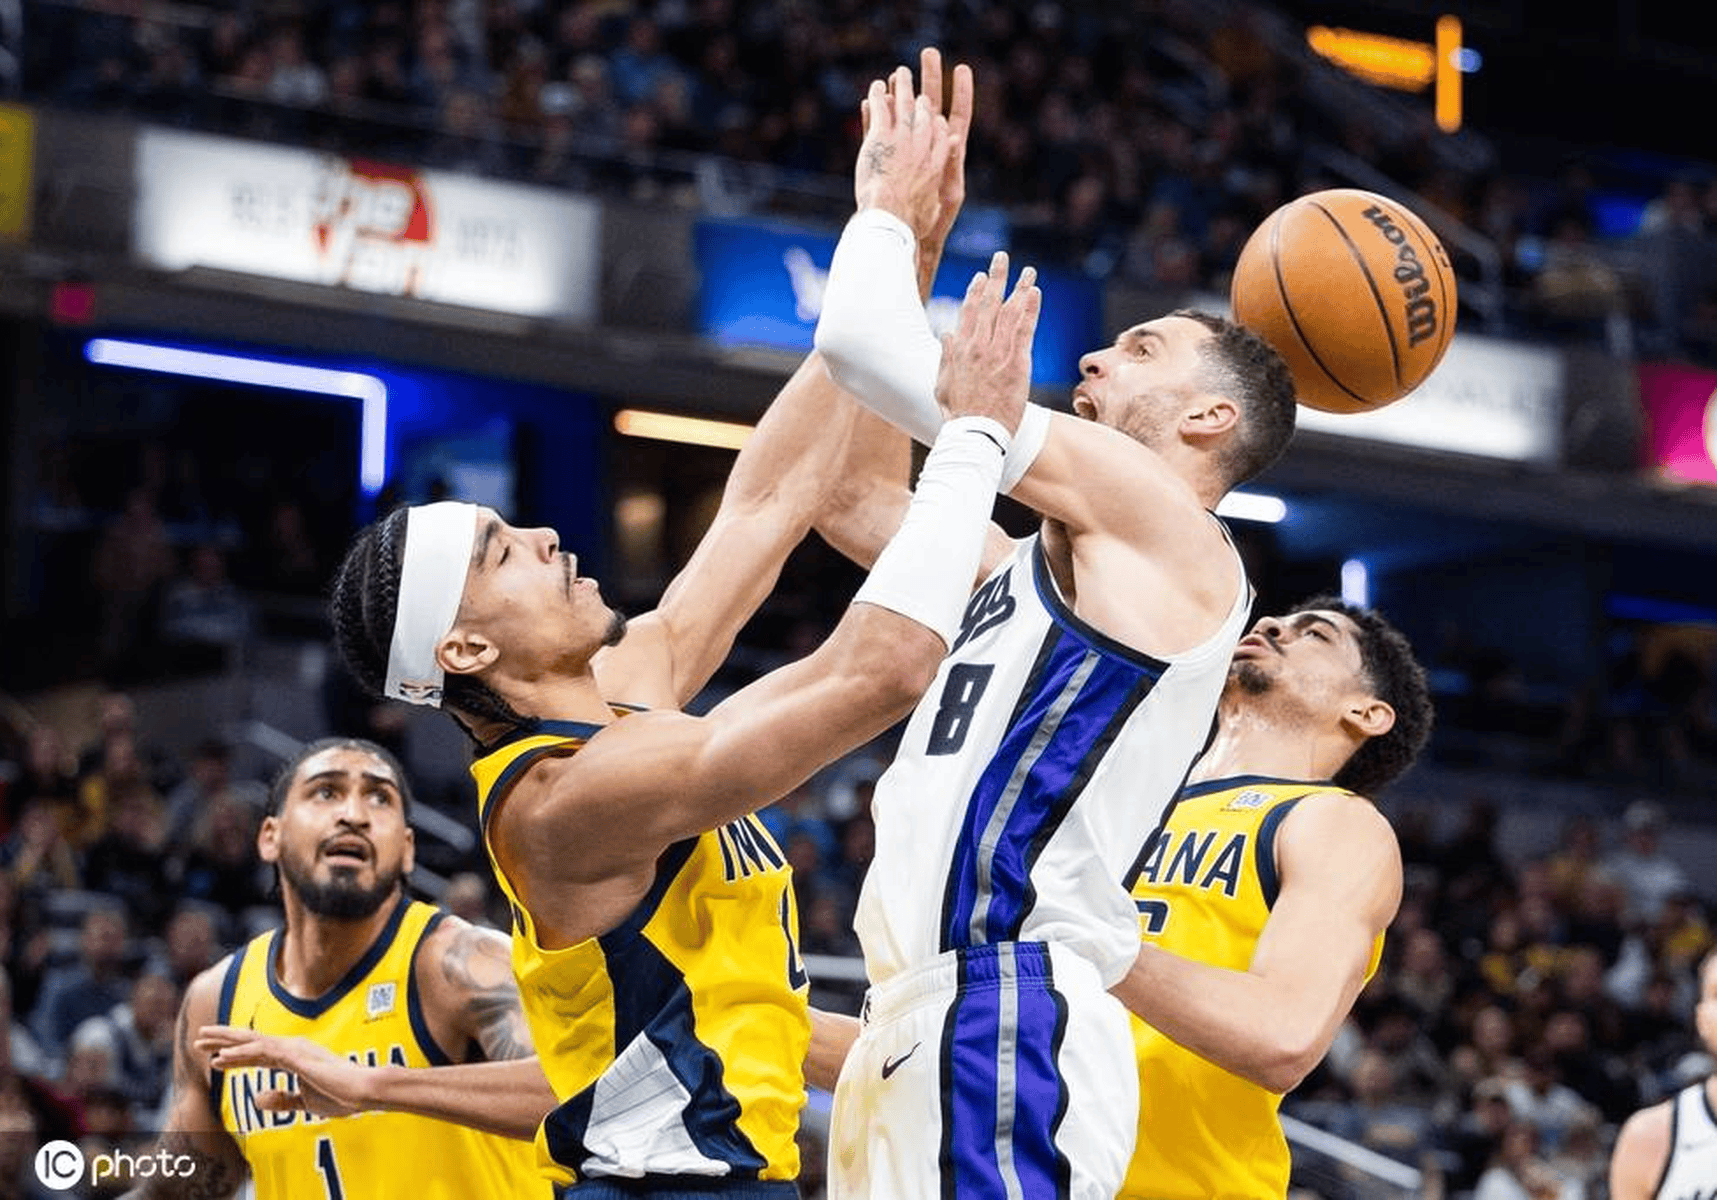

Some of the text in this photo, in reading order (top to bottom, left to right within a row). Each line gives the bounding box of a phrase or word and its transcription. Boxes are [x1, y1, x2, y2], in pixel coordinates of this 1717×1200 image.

[1362, 205, 1438, 349] Wilson
[925, 662, 996, 756] 8
[317, 1138, 344, 1200] 1
